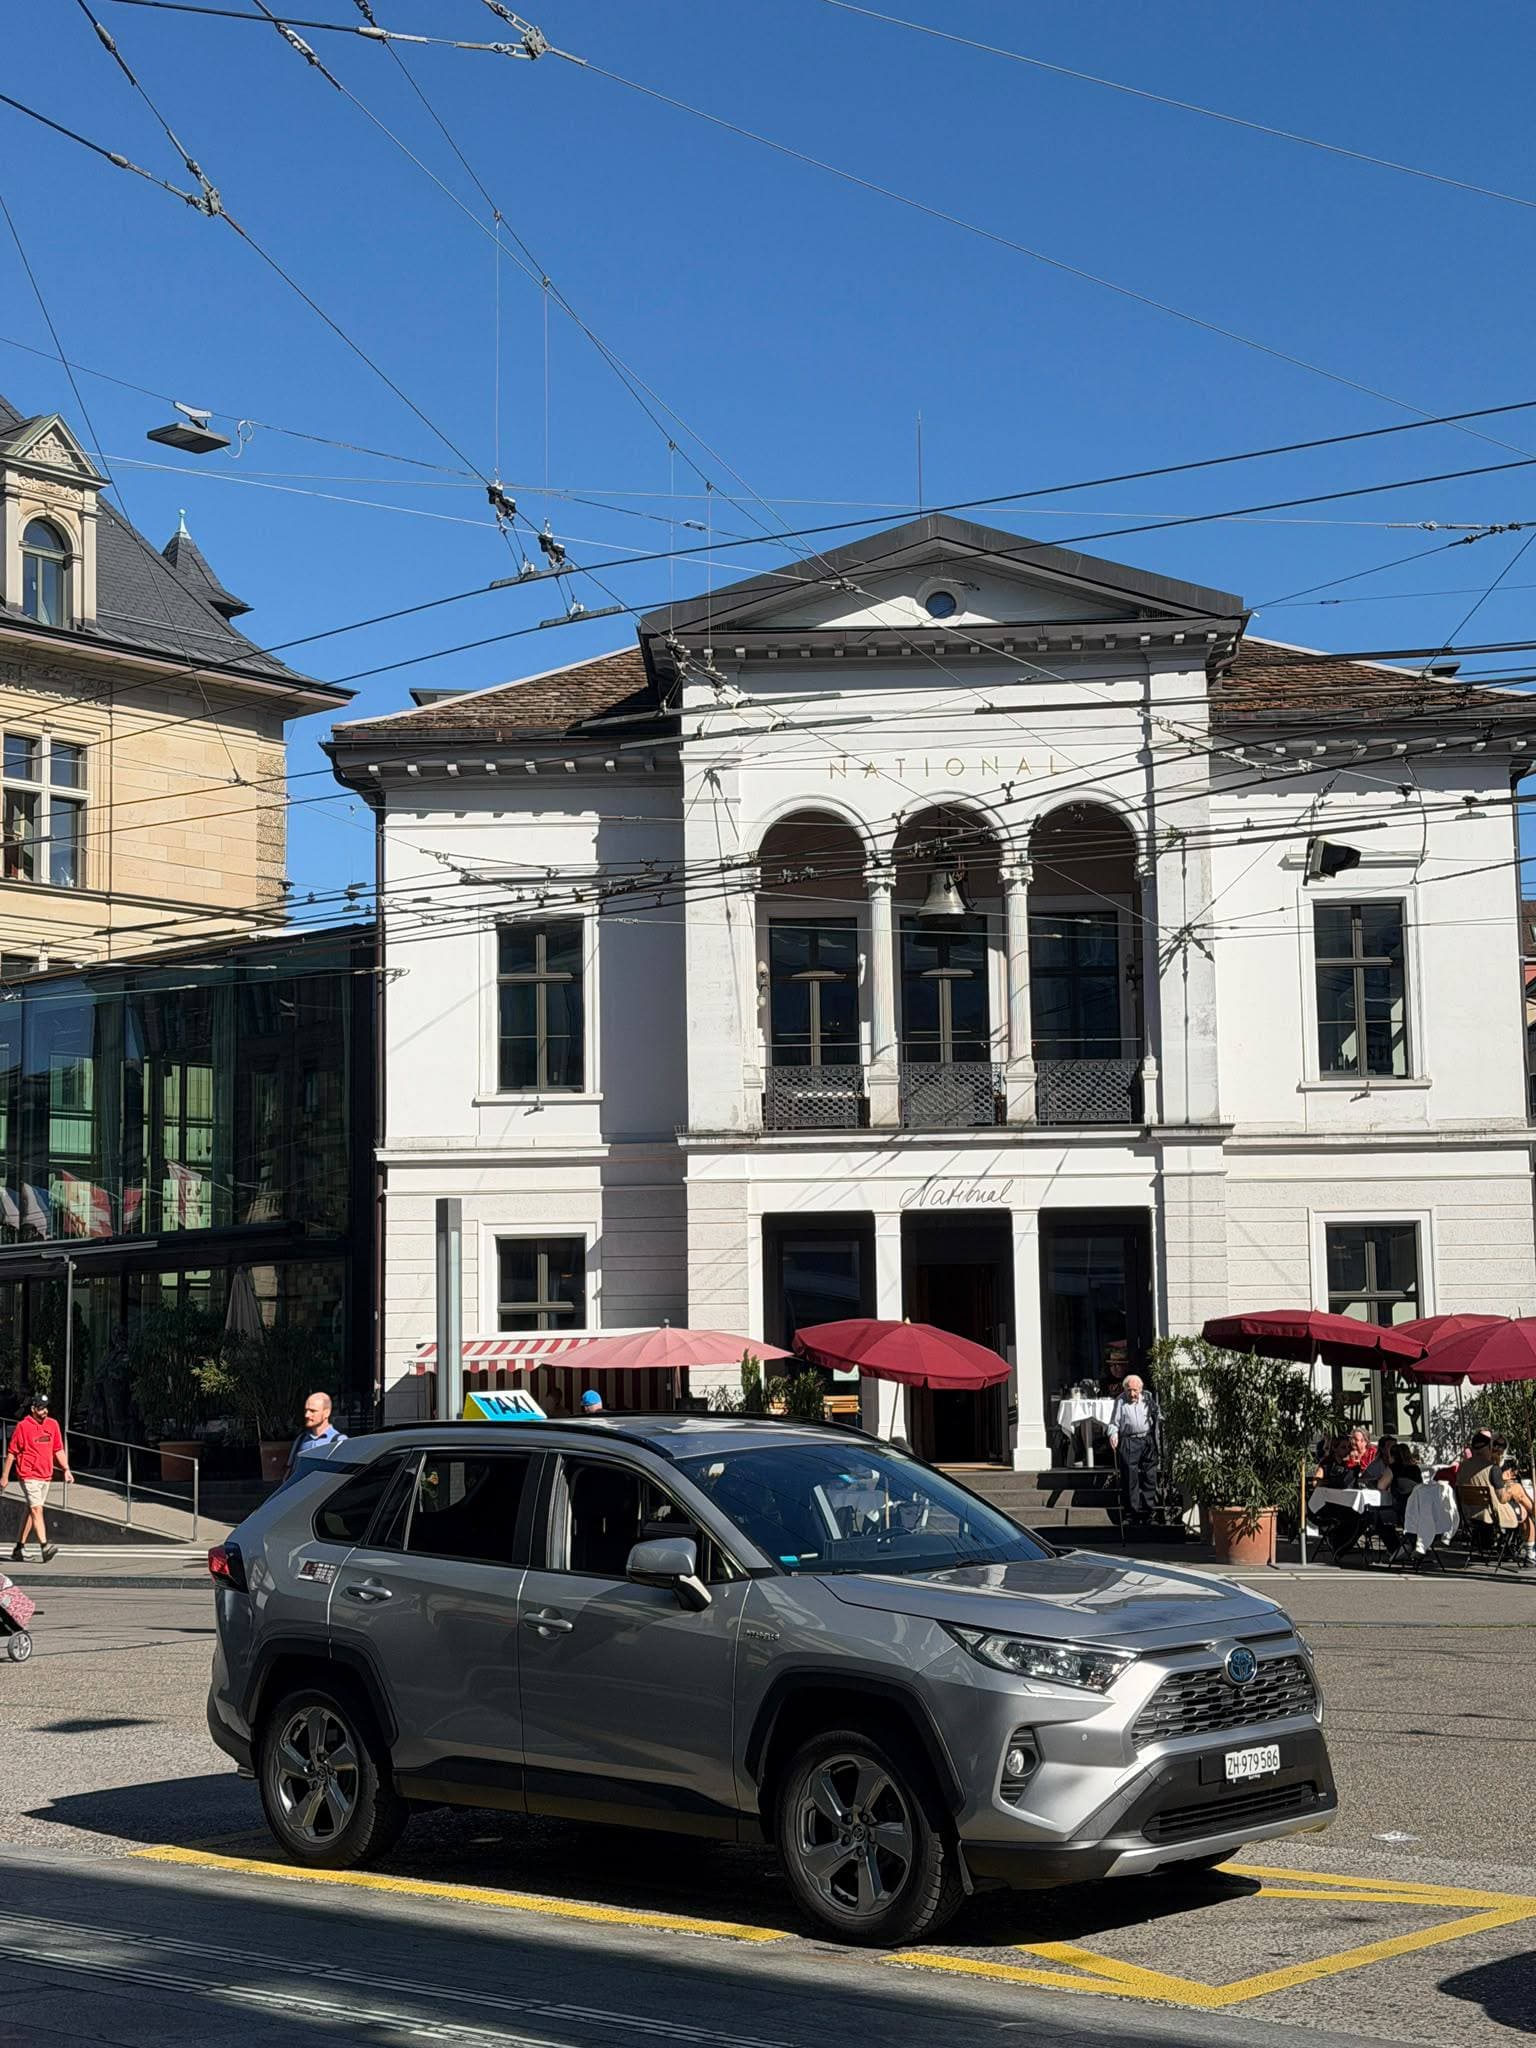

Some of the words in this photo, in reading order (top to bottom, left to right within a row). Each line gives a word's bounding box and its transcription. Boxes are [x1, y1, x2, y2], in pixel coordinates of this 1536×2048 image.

[830, 755, 1063, 779] NATIONAL
[899, 1179, 1014, 1208] National
[480, 1395, 535, 1415] TAXI
